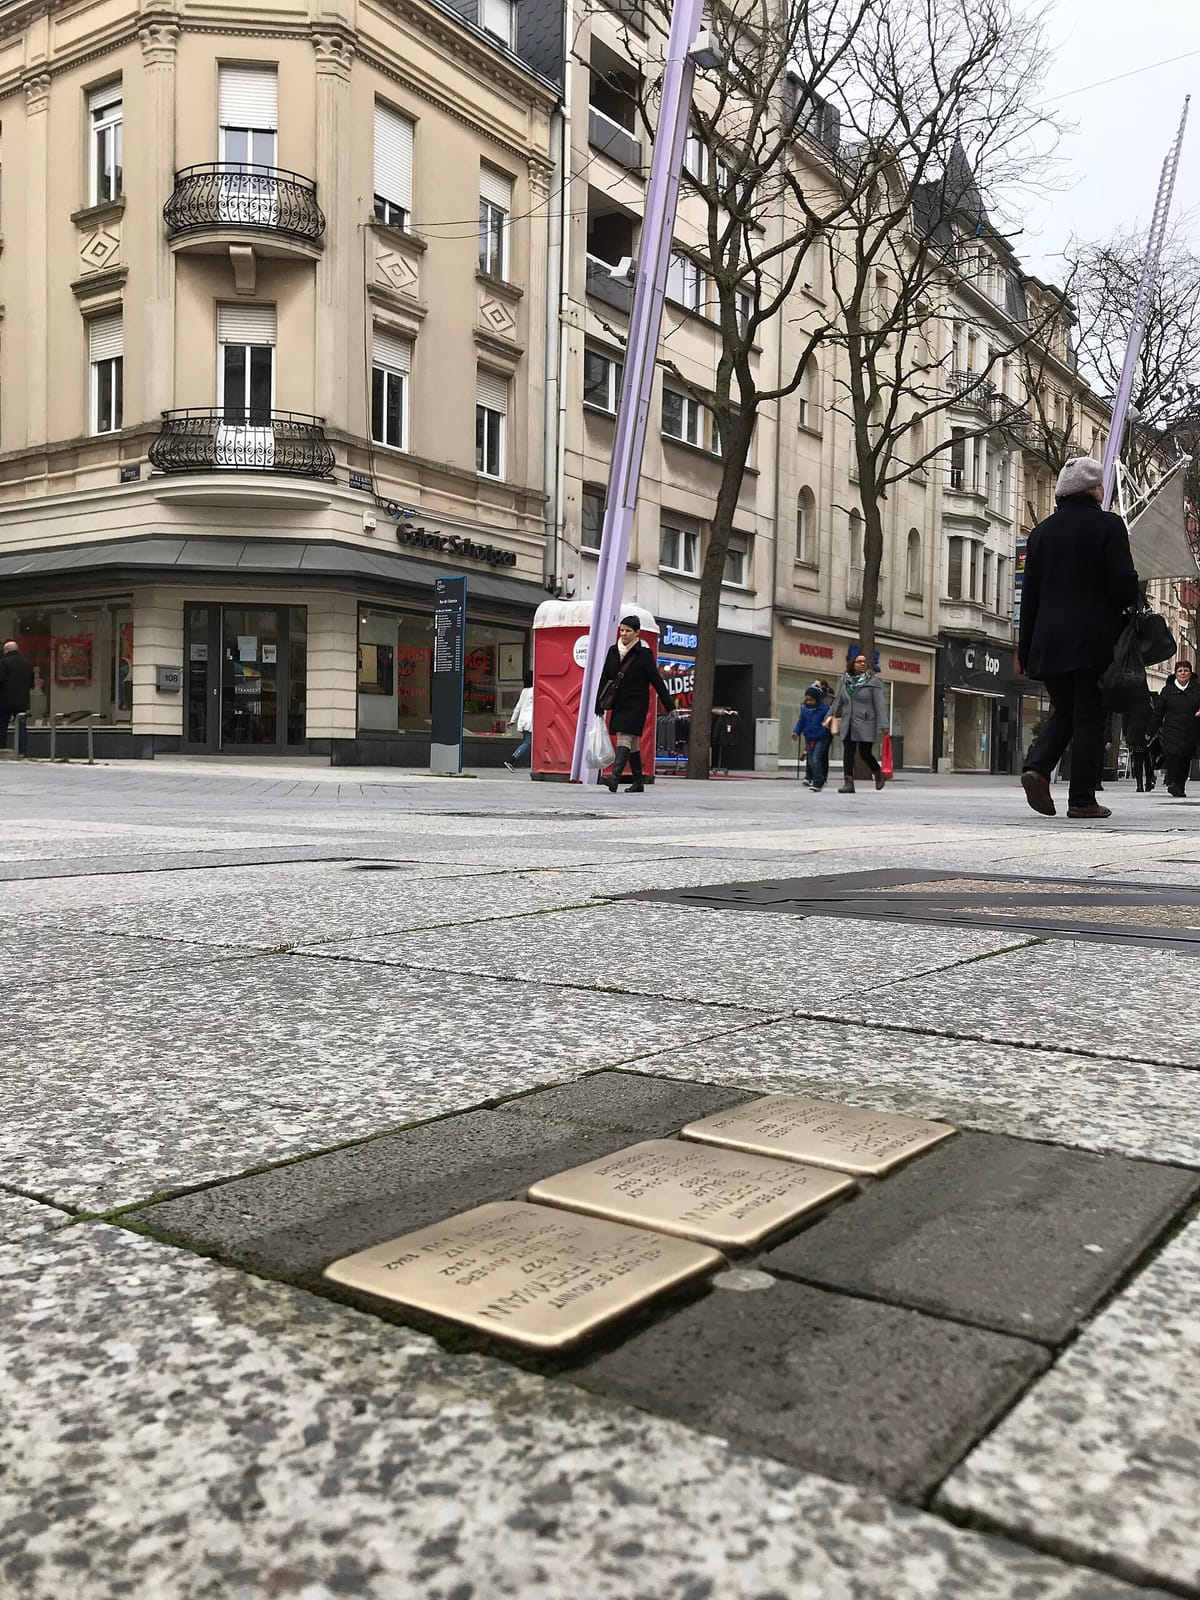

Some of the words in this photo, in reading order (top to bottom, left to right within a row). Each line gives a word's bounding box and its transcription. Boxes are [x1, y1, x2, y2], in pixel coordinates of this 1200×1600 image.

[165, 674, 178, 683] 108
[382, 1254, 420, 1270] 1942
[439, 1259, 477, 1275] 1942
[520, 1257, 558, 1274] 1927
